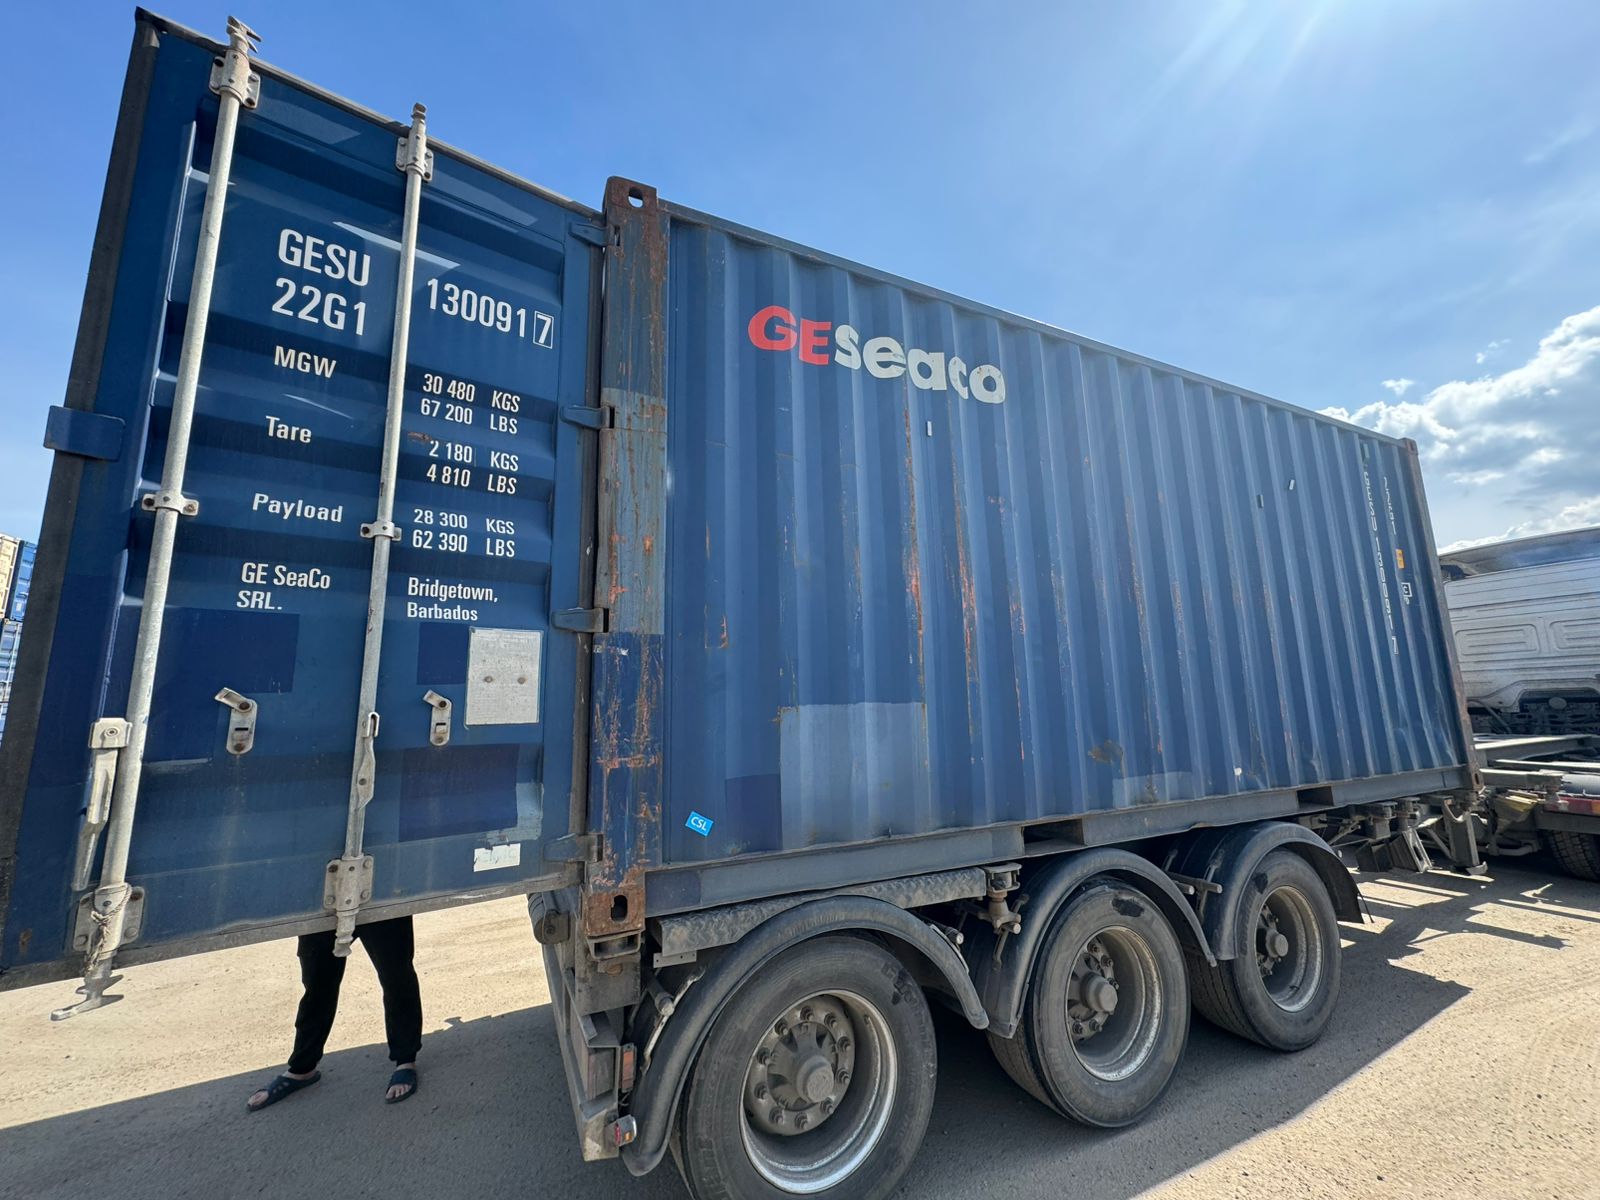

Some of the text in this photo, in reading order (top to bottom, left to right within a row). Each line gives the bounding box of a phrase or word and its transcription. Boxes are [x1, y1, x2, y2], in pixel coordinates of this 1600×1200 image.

[278, 228, 371, 287] GESU
[271, 277, 368, 336] 22G1
[274, 345, 337, 378] MGW
[422, 373, 521, 413] 30 480 KGS
[265, 415, 312, 443] Tare
[420, 398, 518, 435] 67 200 LBS
[429, 440, 519, 472] 2 180 KGS
[426, 463, 517, 495] 4 810 LBS
[252, 493, 343, 523] Payload
[413, 508, 515, 535] 28 300 KGS
[412, 529, 515, 558] 62 390 LBS
[241, 562, 331, 589] GE SeaCo
[407, 576, 498, 603] Bridgetown,
[236, 590, 282, 610] SRL.
[407, 602, 478, 621] Barbados
